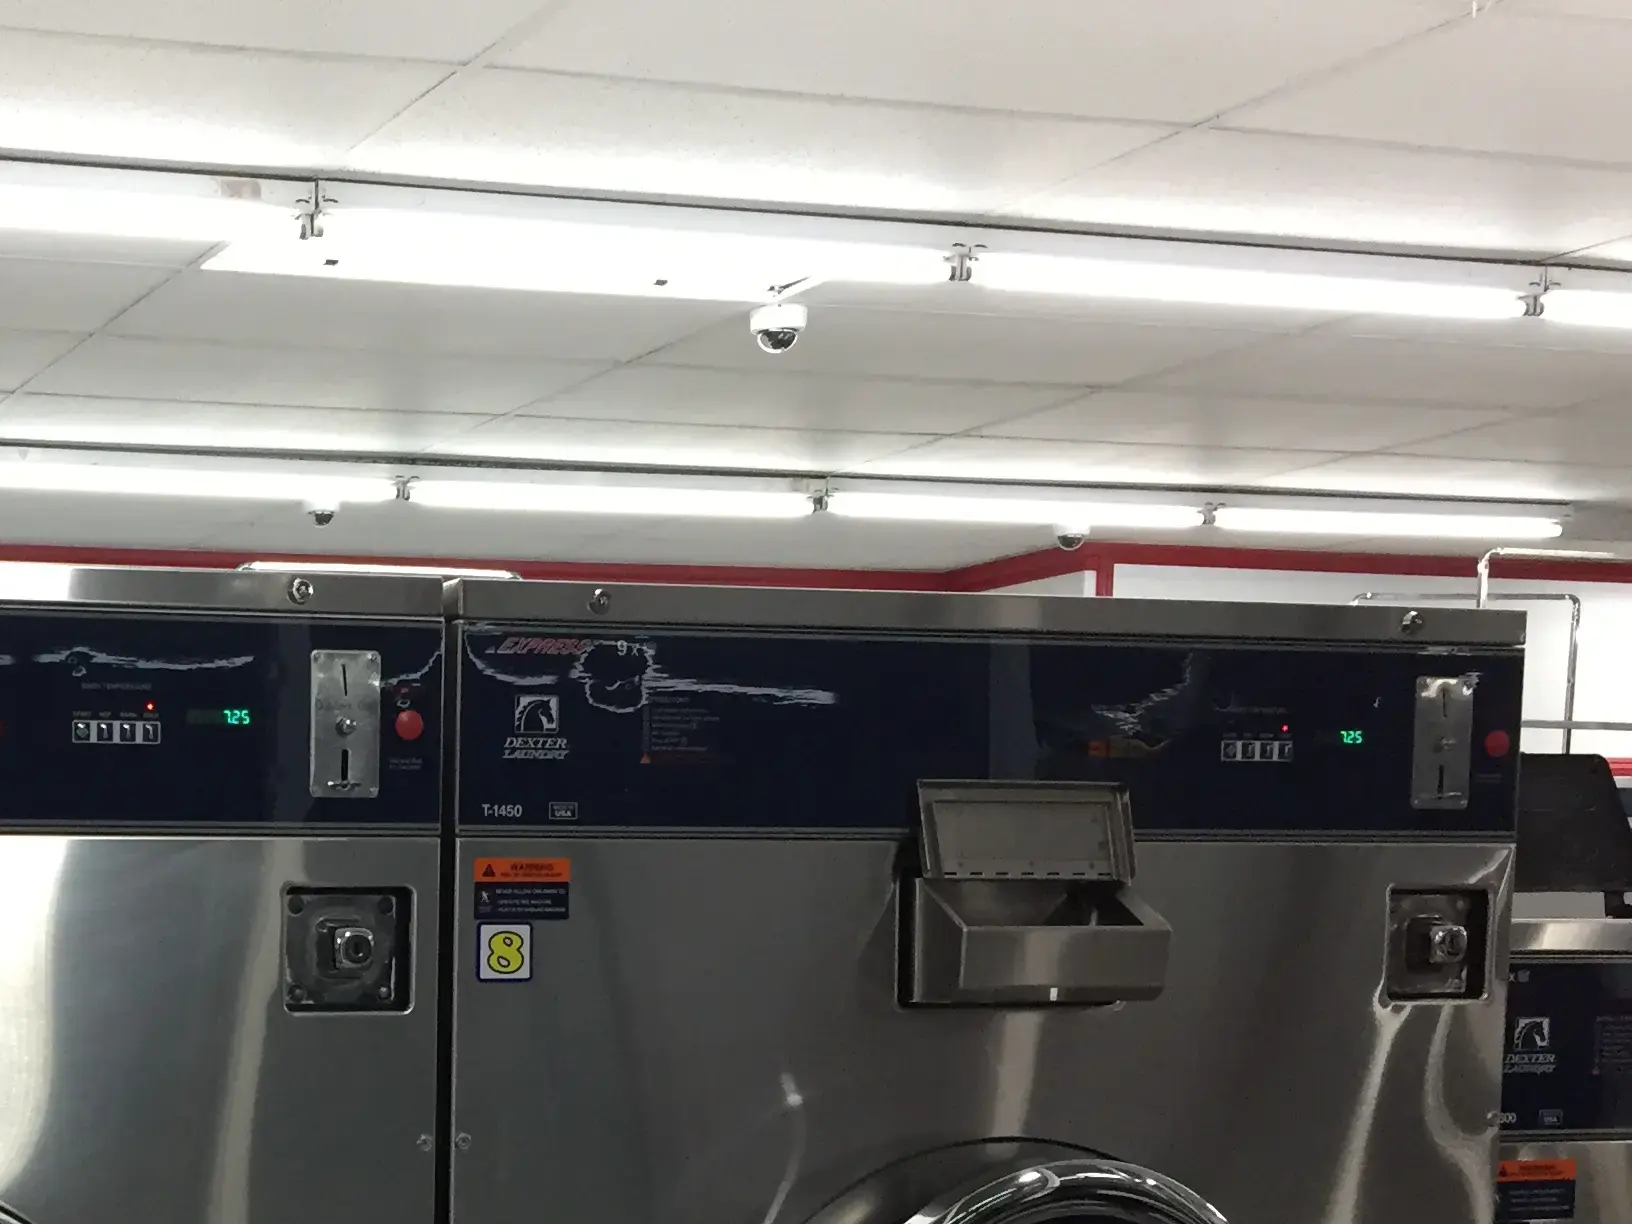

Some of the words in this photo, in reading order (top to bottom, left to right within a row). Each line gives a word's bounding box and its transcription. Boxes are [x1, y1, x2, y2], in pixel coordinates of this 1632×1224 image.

[616, 640, 628, 656] 9
[503, 736, 568, 749] DEXTER
[502, 749, 571, 760] LAUNDRY
[481, 803, 523, 818] T-1450
[510, 863, 555, 871] WARNING
[487, 930, 525, 974] 8
[1505, 1053, 1557, 1063] DEXTER
